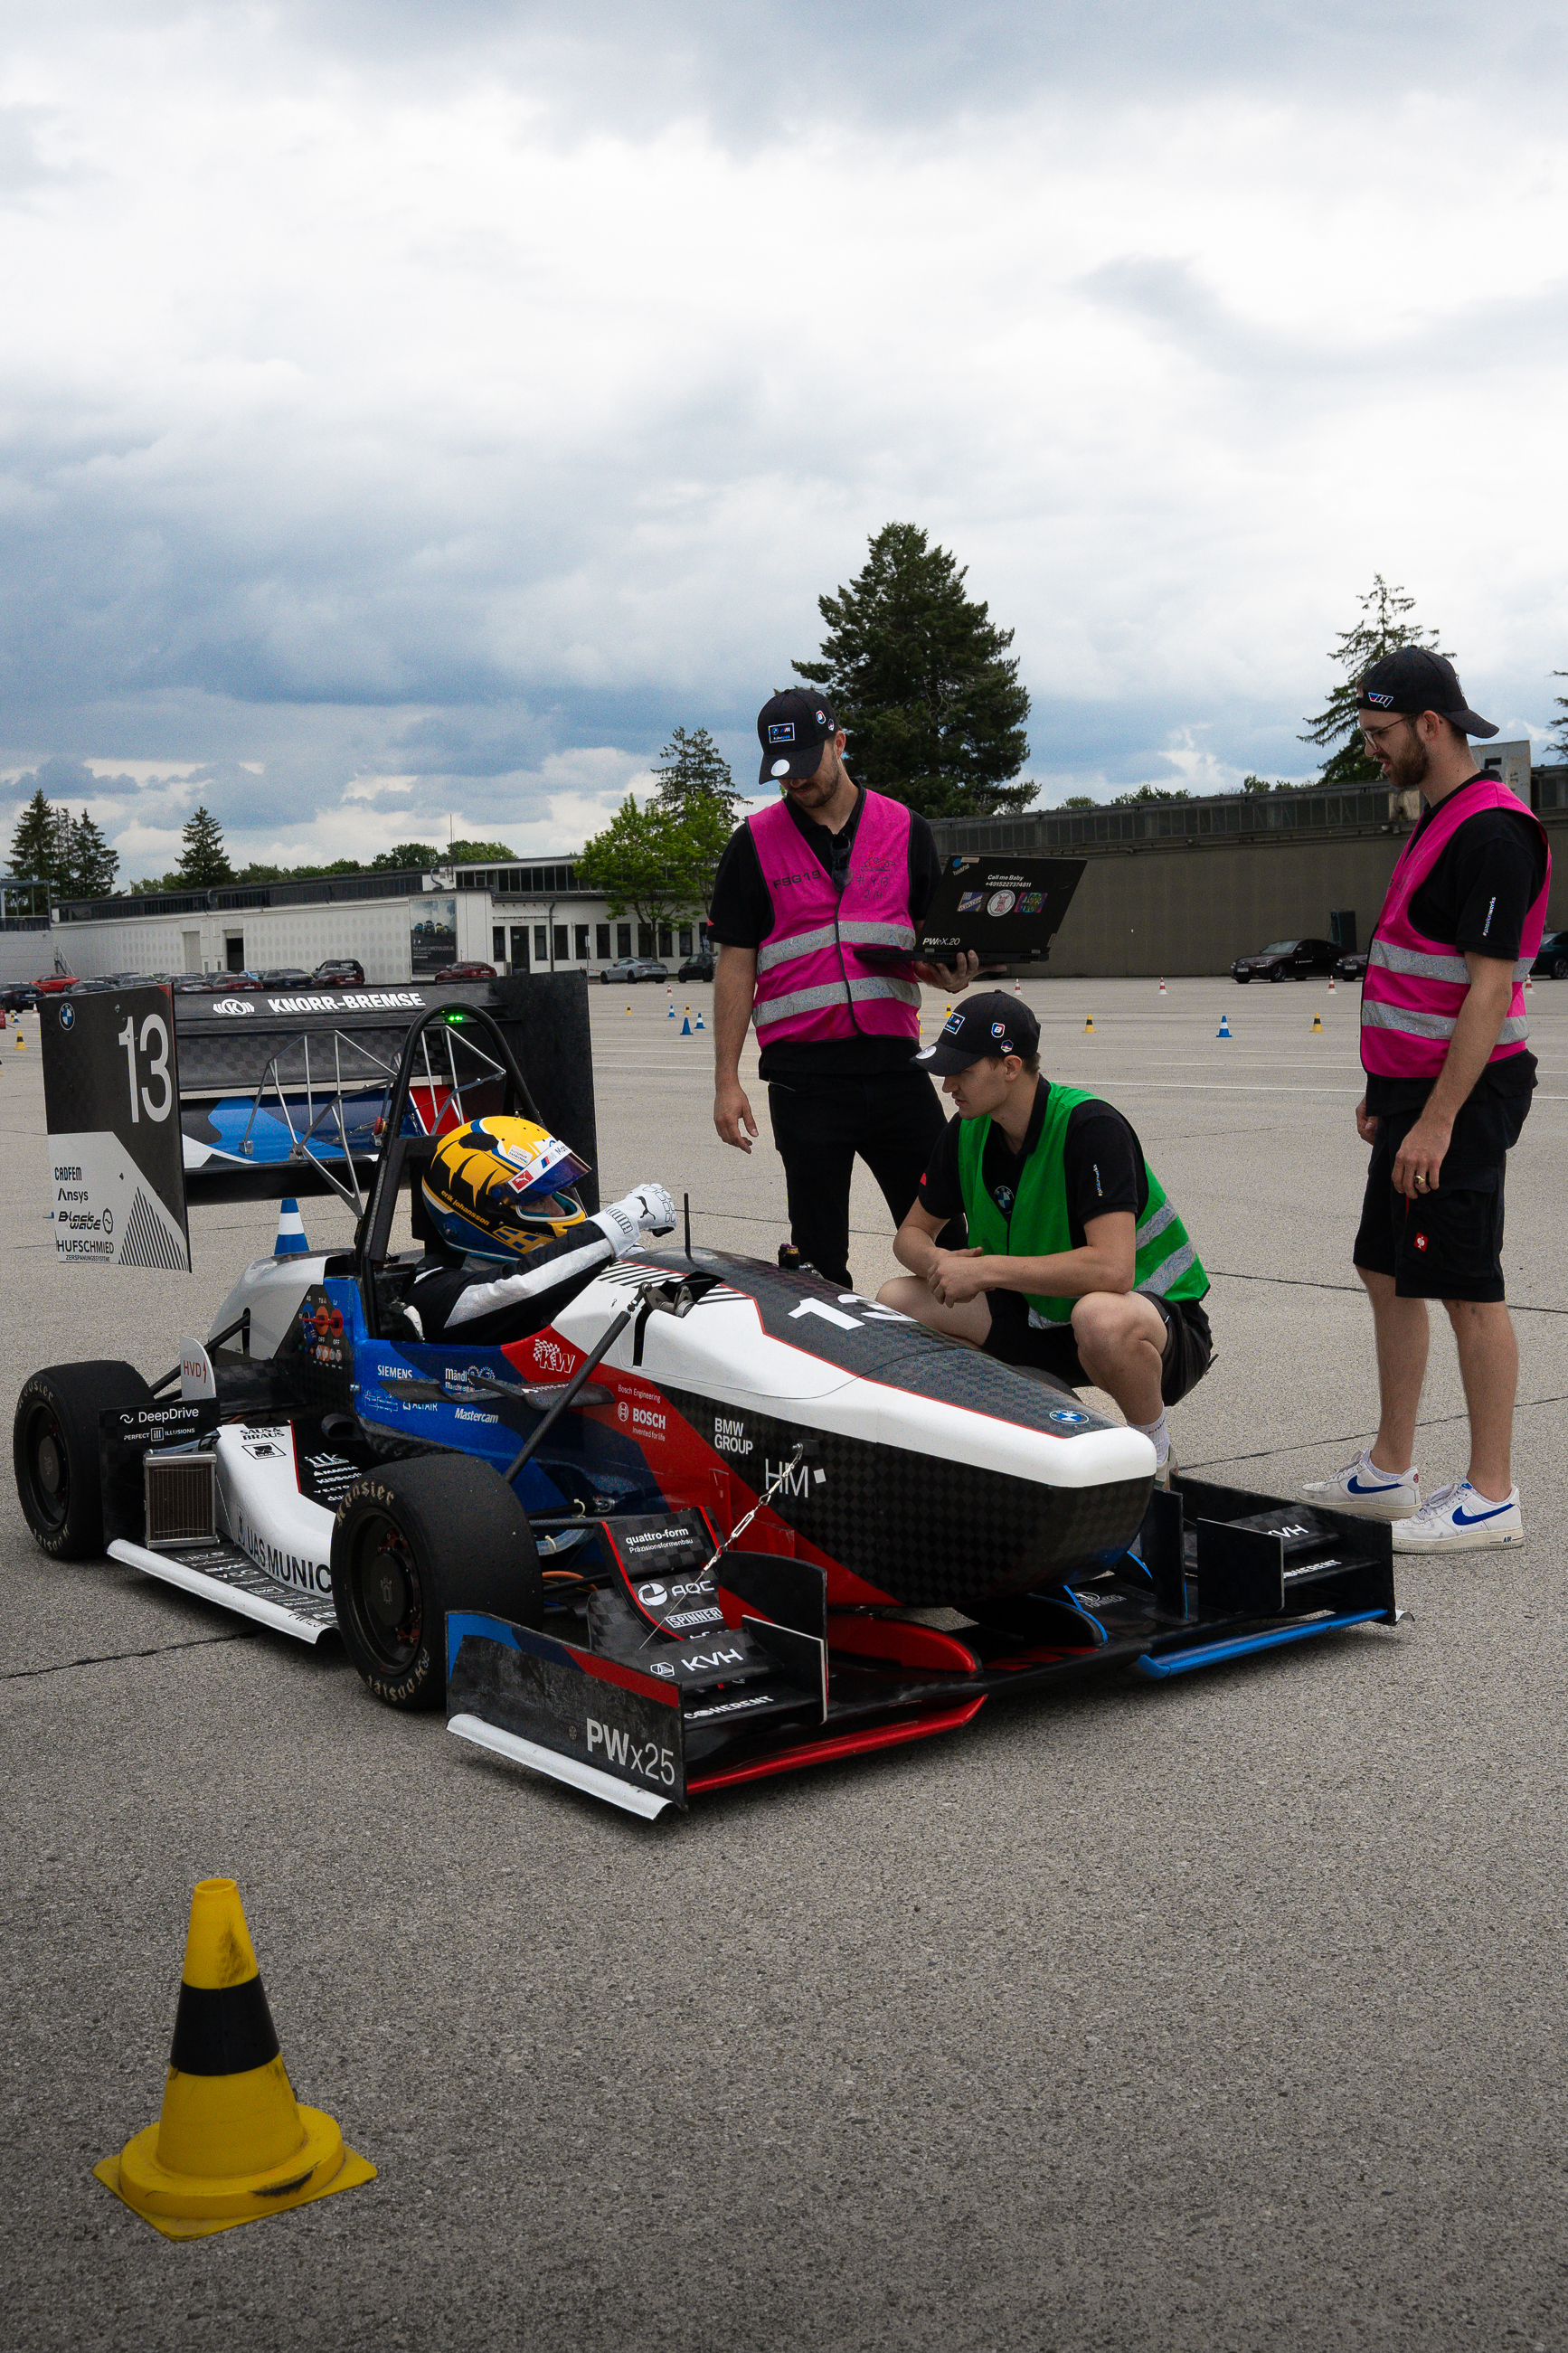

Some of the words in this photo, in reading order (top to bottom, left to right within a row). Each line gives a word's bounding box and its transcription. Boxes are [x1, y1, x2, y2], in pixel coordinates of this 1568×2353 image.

[268, 992, 426, 1013] KNORR-BREMSE
[118, 1013, 173, 1123] 13
[54, 1167, 82, 1181] CADFEM
[58, 1187, 89, 1204] Ansys
[440, 1190, 454, 1203] erik
[452, 1199, 490, 1226] johansson
[57, 1240, 114, 1254] HUFSCHMIED
[183, 1358, 202, 1378] HVD
[377, 1365, 413, 1379] SIEMENS
[618, 1384, 632, 1395] Bosch
[633, 1387, 661, 1403] Engineering
[137, 1407, 199, 1423] DeepDrive
[454, 1407, 499, 1424] Mastercam
[633, 1407, 666, 1430] BOSCH
[124, 1432, 150, 1441] PERFECT
[165, 1427, 195, 1437] ILLUSIONS
[632, 1426, 651, 1438] Invented
[657, 1432, 666, 1441] life
[714, 1417, 744, 1437] BMW
[713, 1433, 754, 1456] GROUP
[313, 1484, 351, 1494] VECTO
[625, 1526, 689, 1545] quattro-form
[1268, 1524, 1309, 1538] VH
[628, 1538, 694, 1554] Präzisionsformenbau
[246, 1525, 266, 1567] UAS
[267, 1544, 332, 1594] MUNIC
[671, 1580, 715, 1597] AQC
[669, 1609, 722, 1626] SPINNER
[681, 1649, 744, 1671] KVH
[587, 1717, 675, 1786] PWx25
